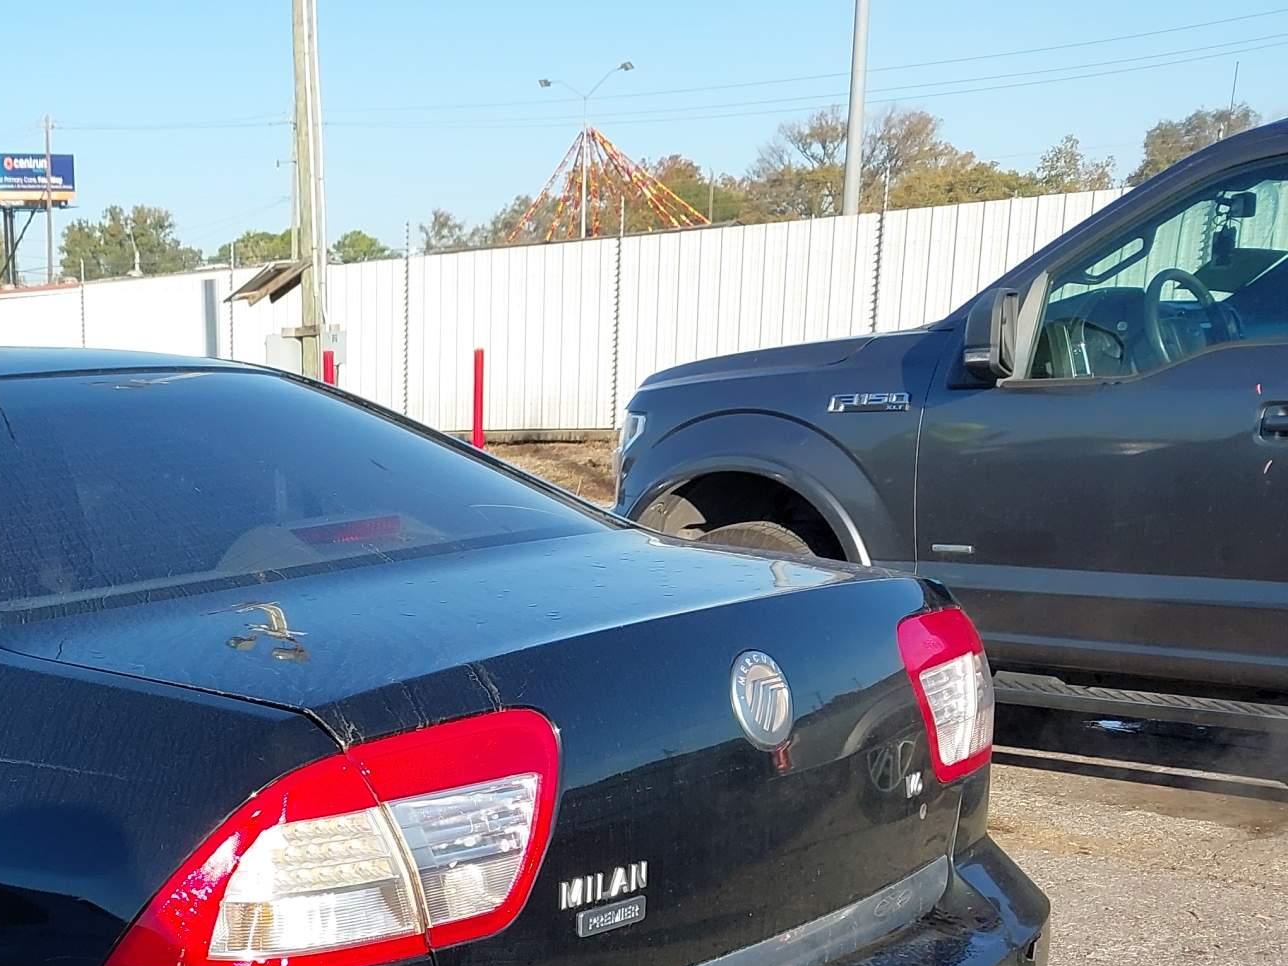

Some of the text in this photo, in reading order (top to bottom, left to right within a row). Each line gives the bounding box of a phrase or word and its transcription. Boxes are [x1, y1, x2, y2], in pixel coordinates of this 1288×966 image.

[905, 771, 923, 798] V6
[558, 860, 648, 910] MILAN
[588, 903, 640, 930] PREMIER
